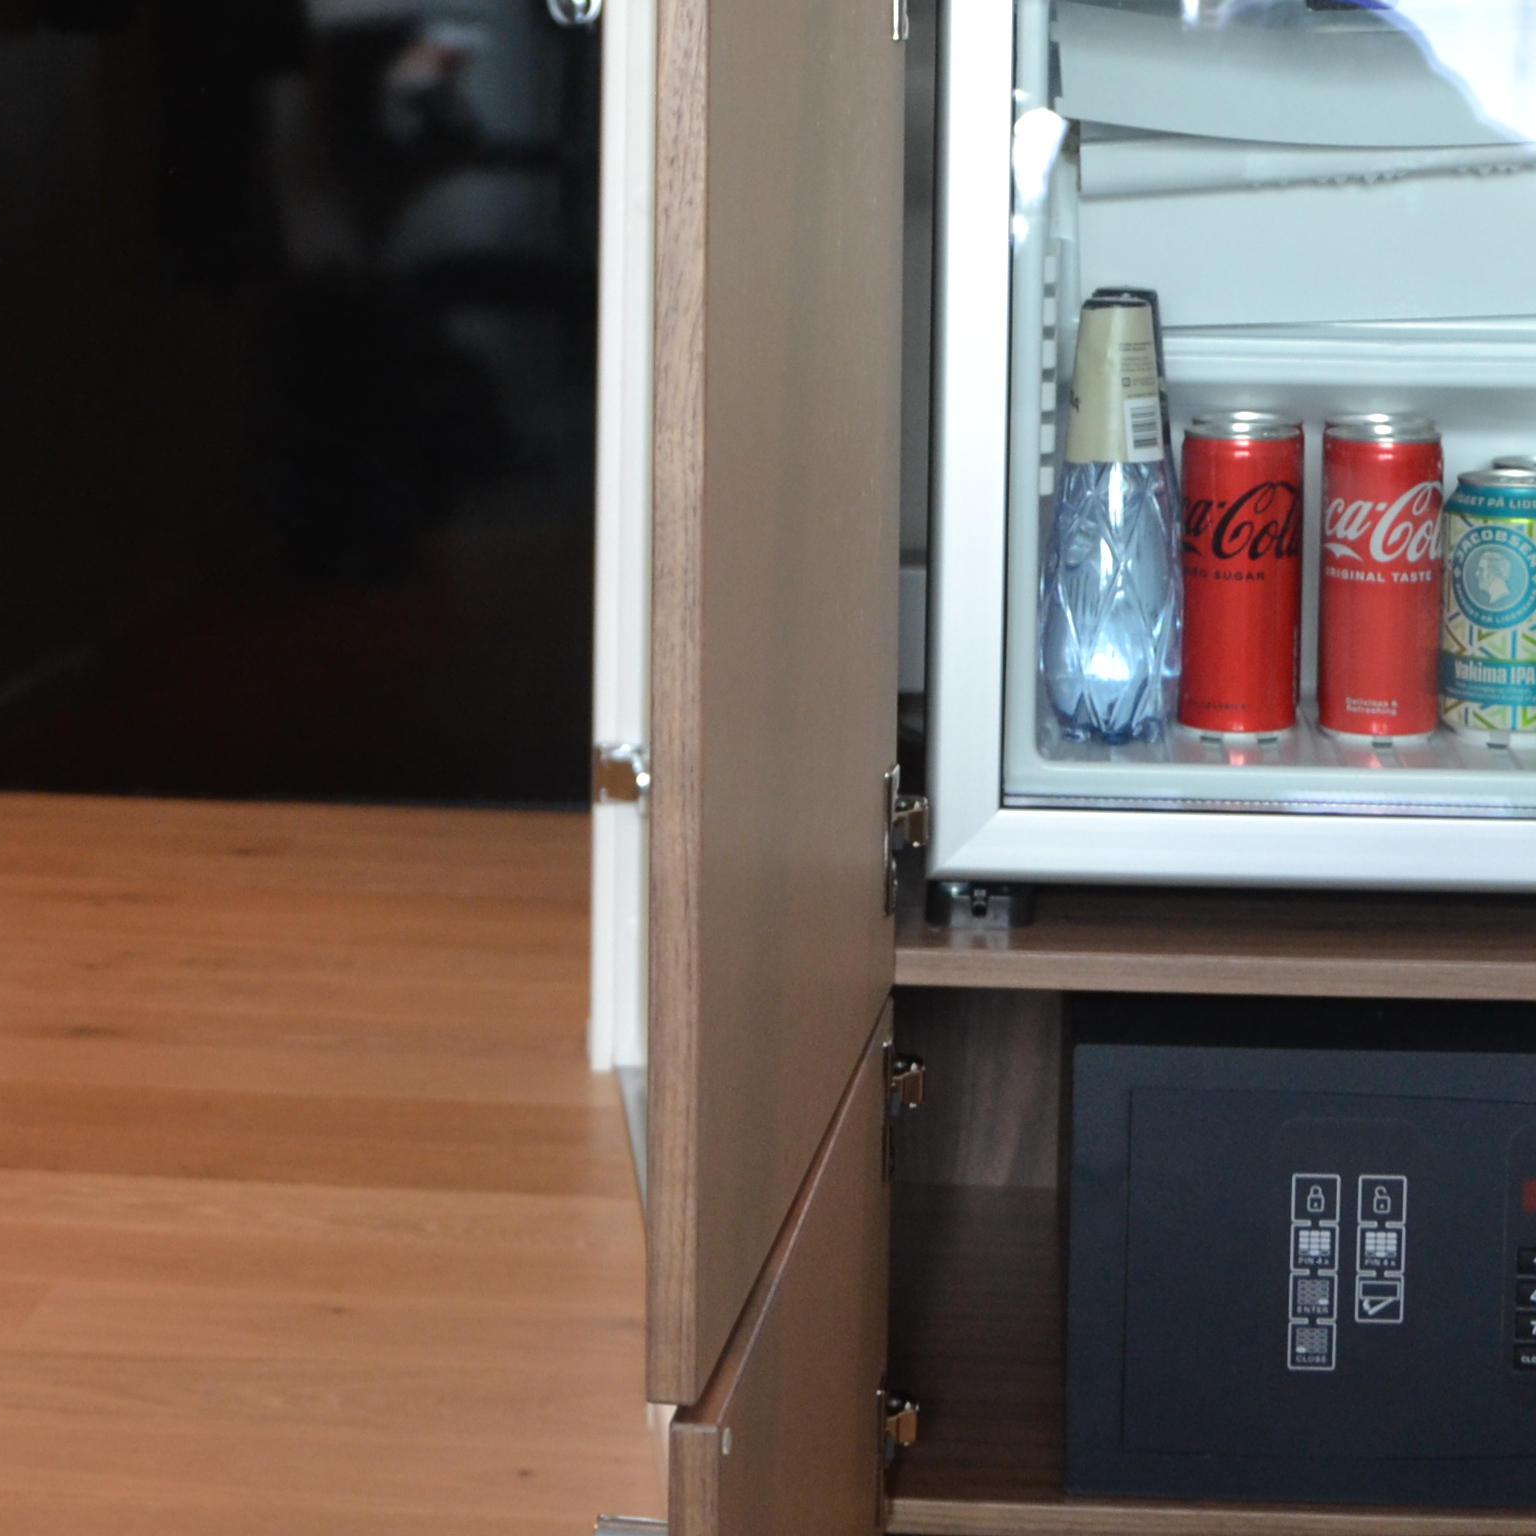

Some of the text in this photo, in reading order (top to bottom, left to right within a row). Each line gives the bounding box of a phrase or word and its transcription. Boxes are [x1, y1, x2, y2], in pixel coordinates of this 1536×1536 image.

[1214, 570, 1265, 581] SUGAR
[1392, 571, 1432, 582] TASTE
[1455, 660, 1536, 685] Yakima IPA
